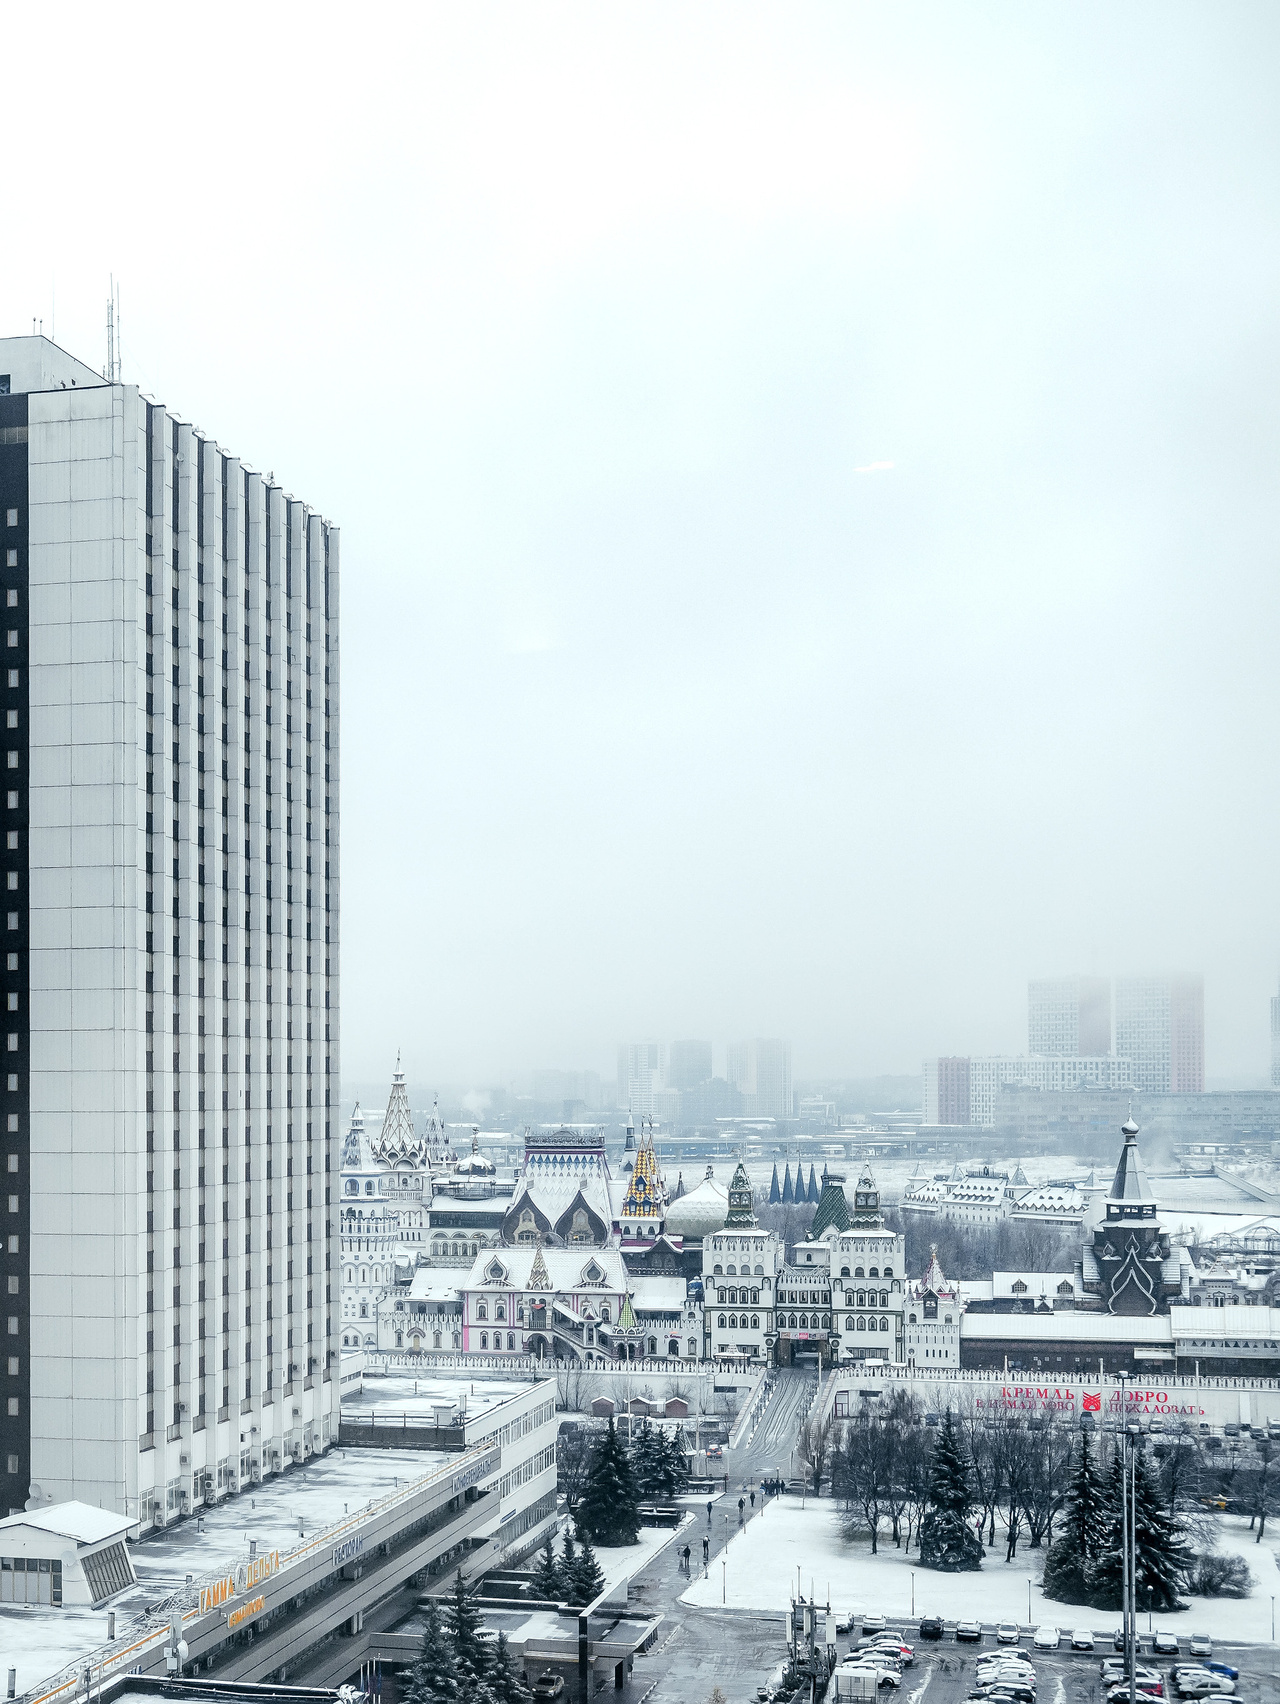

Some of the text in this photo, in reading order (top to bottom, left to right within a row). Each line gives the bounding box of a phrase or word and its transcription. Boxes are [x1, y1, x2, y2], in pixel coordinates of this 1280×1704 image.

[1002, 1387, 1075, 1400] КРЕМЛЬ
[1109, 1391, 1168, 1403] ДОБРО
[1109, 1403, 1205, 1415] ПОЖАЛОВАТЬ
[332, 1533, 363, 1566] РЕСТОРАН
[199, 1549, 280, 1616] ГАММА ДЕЛЬТА
